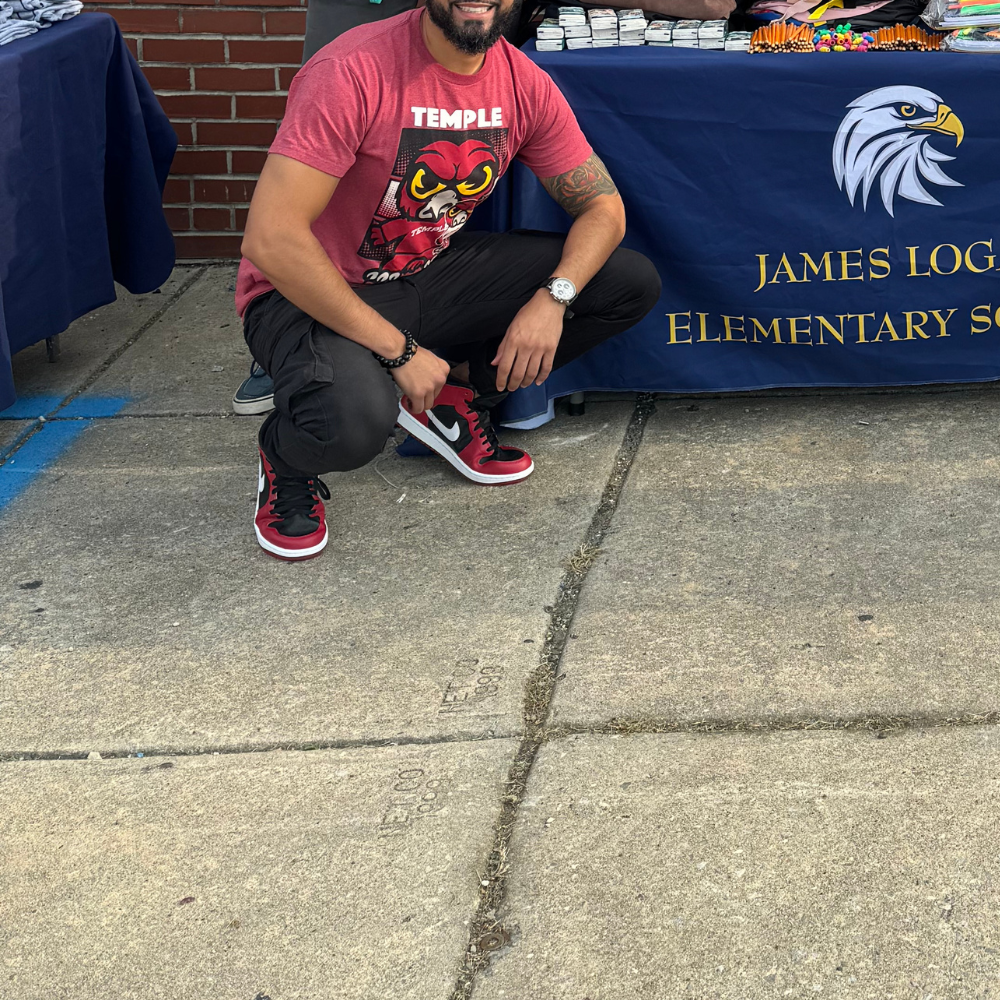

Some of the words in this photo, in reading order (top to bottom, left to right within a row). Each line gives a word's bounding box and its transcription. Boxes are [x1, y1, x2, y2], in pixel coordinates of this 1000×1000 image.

[411, 106, 503, 129] TEMPLE
[753, 246, 891, 293] JAMES
[665, 308, 957, 346] ELEMENTARY
